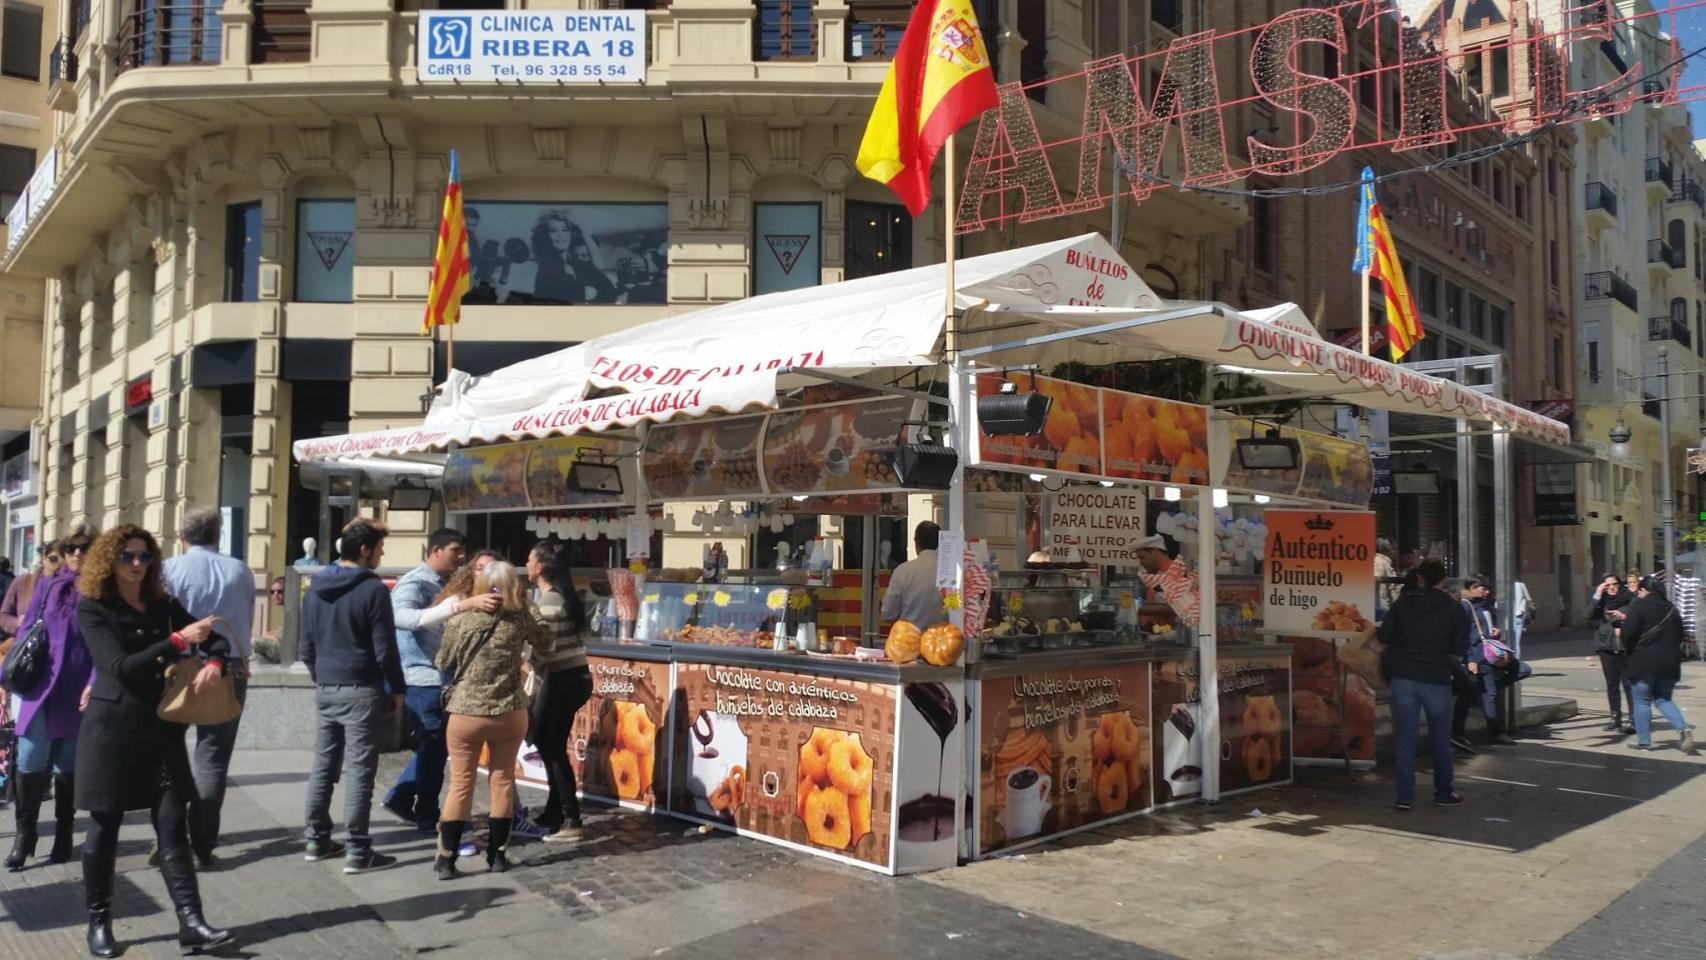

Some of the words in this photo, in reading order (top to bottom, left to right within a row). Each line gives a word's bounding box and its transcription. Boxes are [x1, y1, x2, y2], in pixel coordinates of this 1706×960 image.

[480, 16, 554, 32] CLINICA
[565, 16, 636, 32] DENTAL
[481, 39, 591, 57] RIBERA
[602, 39, 635, 57] 18
[427, 63, 472, 76] CdR18
[491, 64, 519, 76] Tel.
[525, 64, 544, 76] 96
[550, 64, 578, 76] 328
[583, 64, 602, 76] 55
[607, 64, 626, 76] 54
[1066, 249, 1128, 281] BUÑUELOS
[1086, 275, 1105, 300] de
[1238, 320, 1323, 366] CHOCOLATE
[1335, 351, 1394, 386] CHURROS
[592, 401, 616, 423] DE
[616, 388, 702, 419] CALABAZA
[1058, 493, 1137, 510] CHOCOLATE
[1053, 513, 1087, 528] PARA
[1090, 514, 1141, 530] LLEVAR
[1053, 534, 1071, 545] DE
[1086, 536, 1126, 546] LITRO
[1053, 547, 1096, 558] MEIO
[1270, 531, 1368, 561] Auténtico
[1271, 560, 1343, 587] Buñuelo
[1270, 587, 1285, 606] de
[1289, 588, 1318, 610] higo
[706, 664, 762, 691] Chocolate
[765, 678, 785, 693] con
[788, 680, 858, 702] auténticos
[1013, 671, 1064, 697] Chocolate
[716, 690, 764, 716] buñuelos
[767, 698, 784, 716] de
[788, 698, 838, 718] calabaza
[1024, 700, 1065, 729] buñuelos
[1084, 690, 1120, 710] calabaza
